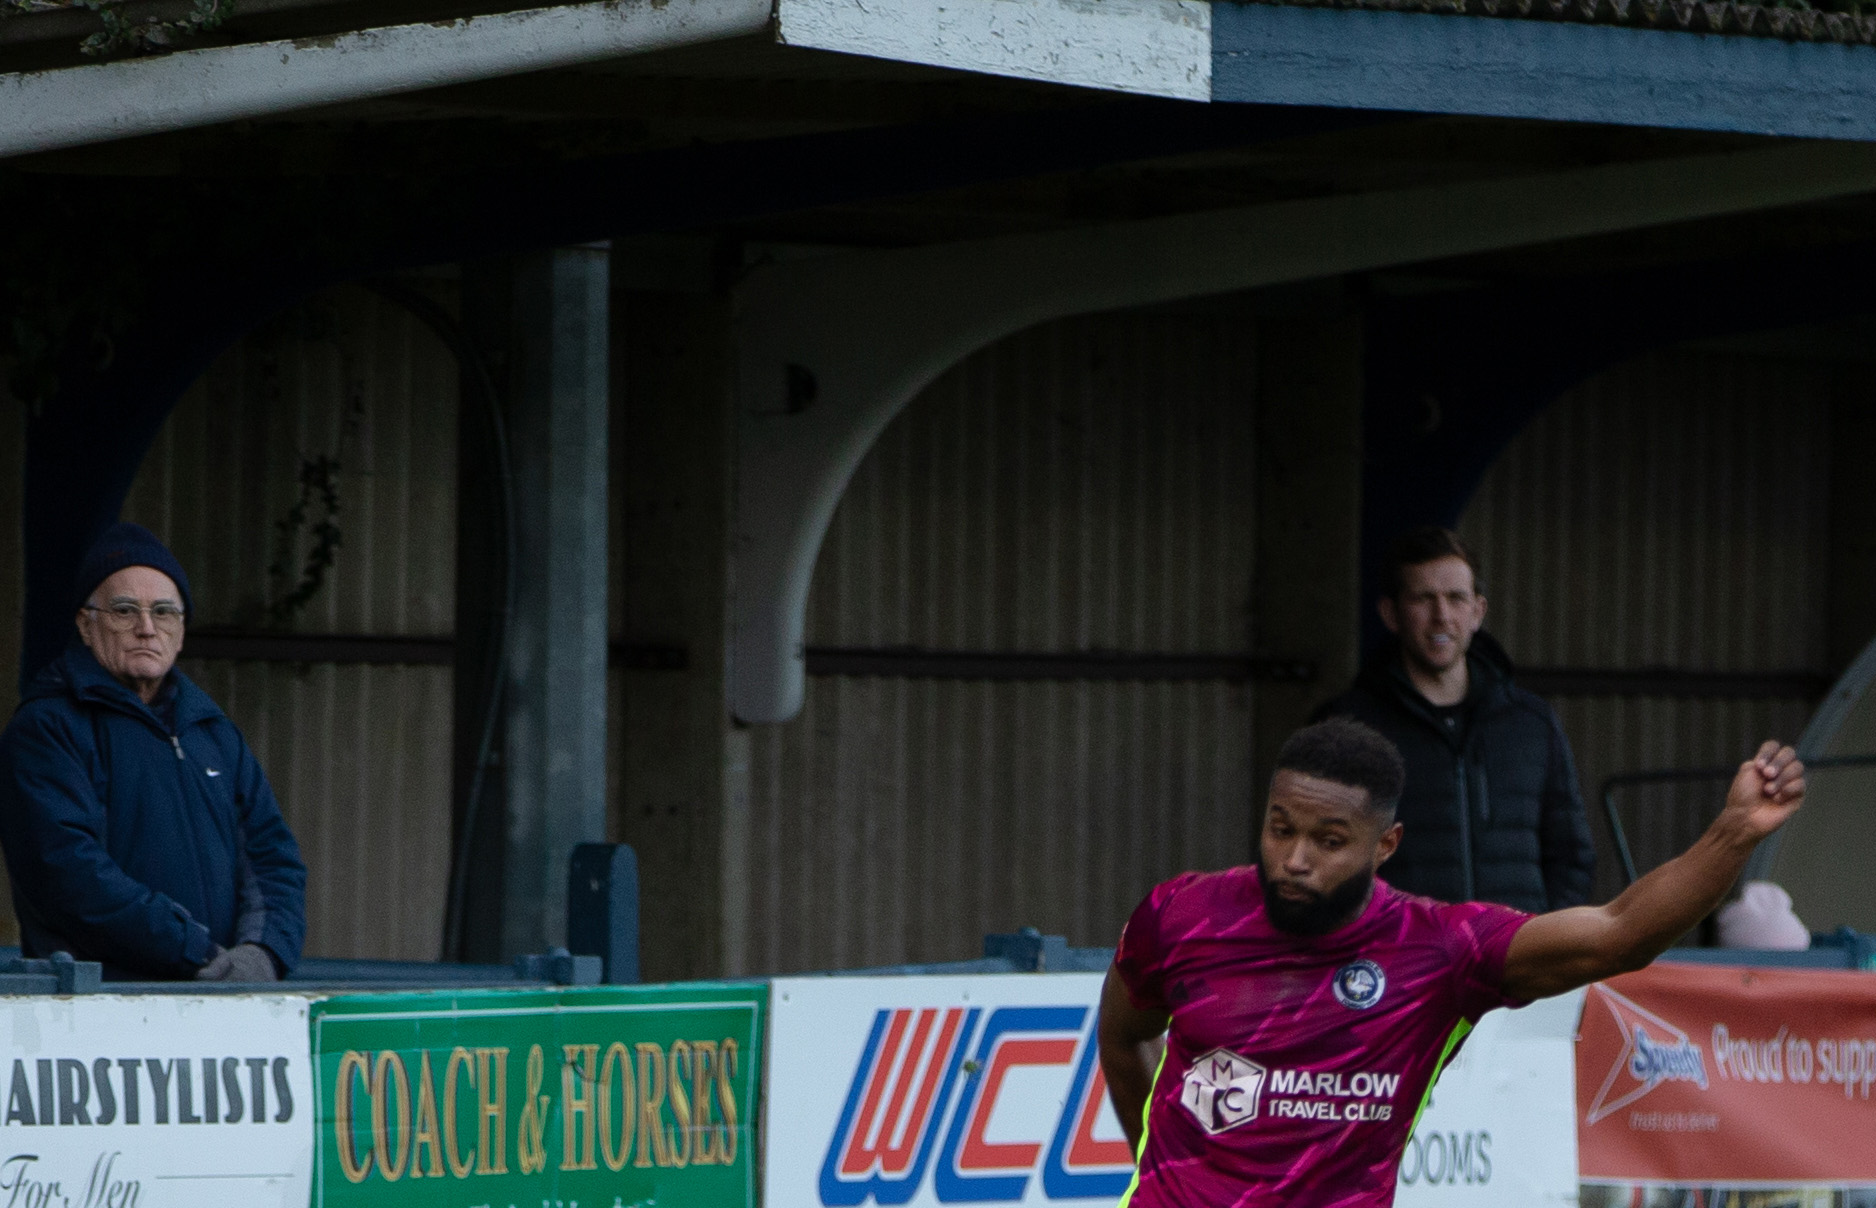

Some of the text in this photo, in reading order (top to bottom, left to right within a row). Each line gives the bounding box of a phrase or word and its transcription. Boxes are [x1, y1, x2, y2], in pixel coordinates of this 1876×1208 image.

[1711, 1023, 1788, 1083] Proud
[1786, 1034, 1814, 1083] to
[4, 1056, 294, 1126] AIRSTYLISTS
[334, 1037, 738, 1183] COACH & HORSES
[1269, 1099, 1393, 1121] TRAVEL CLUB
[1270, 1069, 1400, 1098] MARLOW
